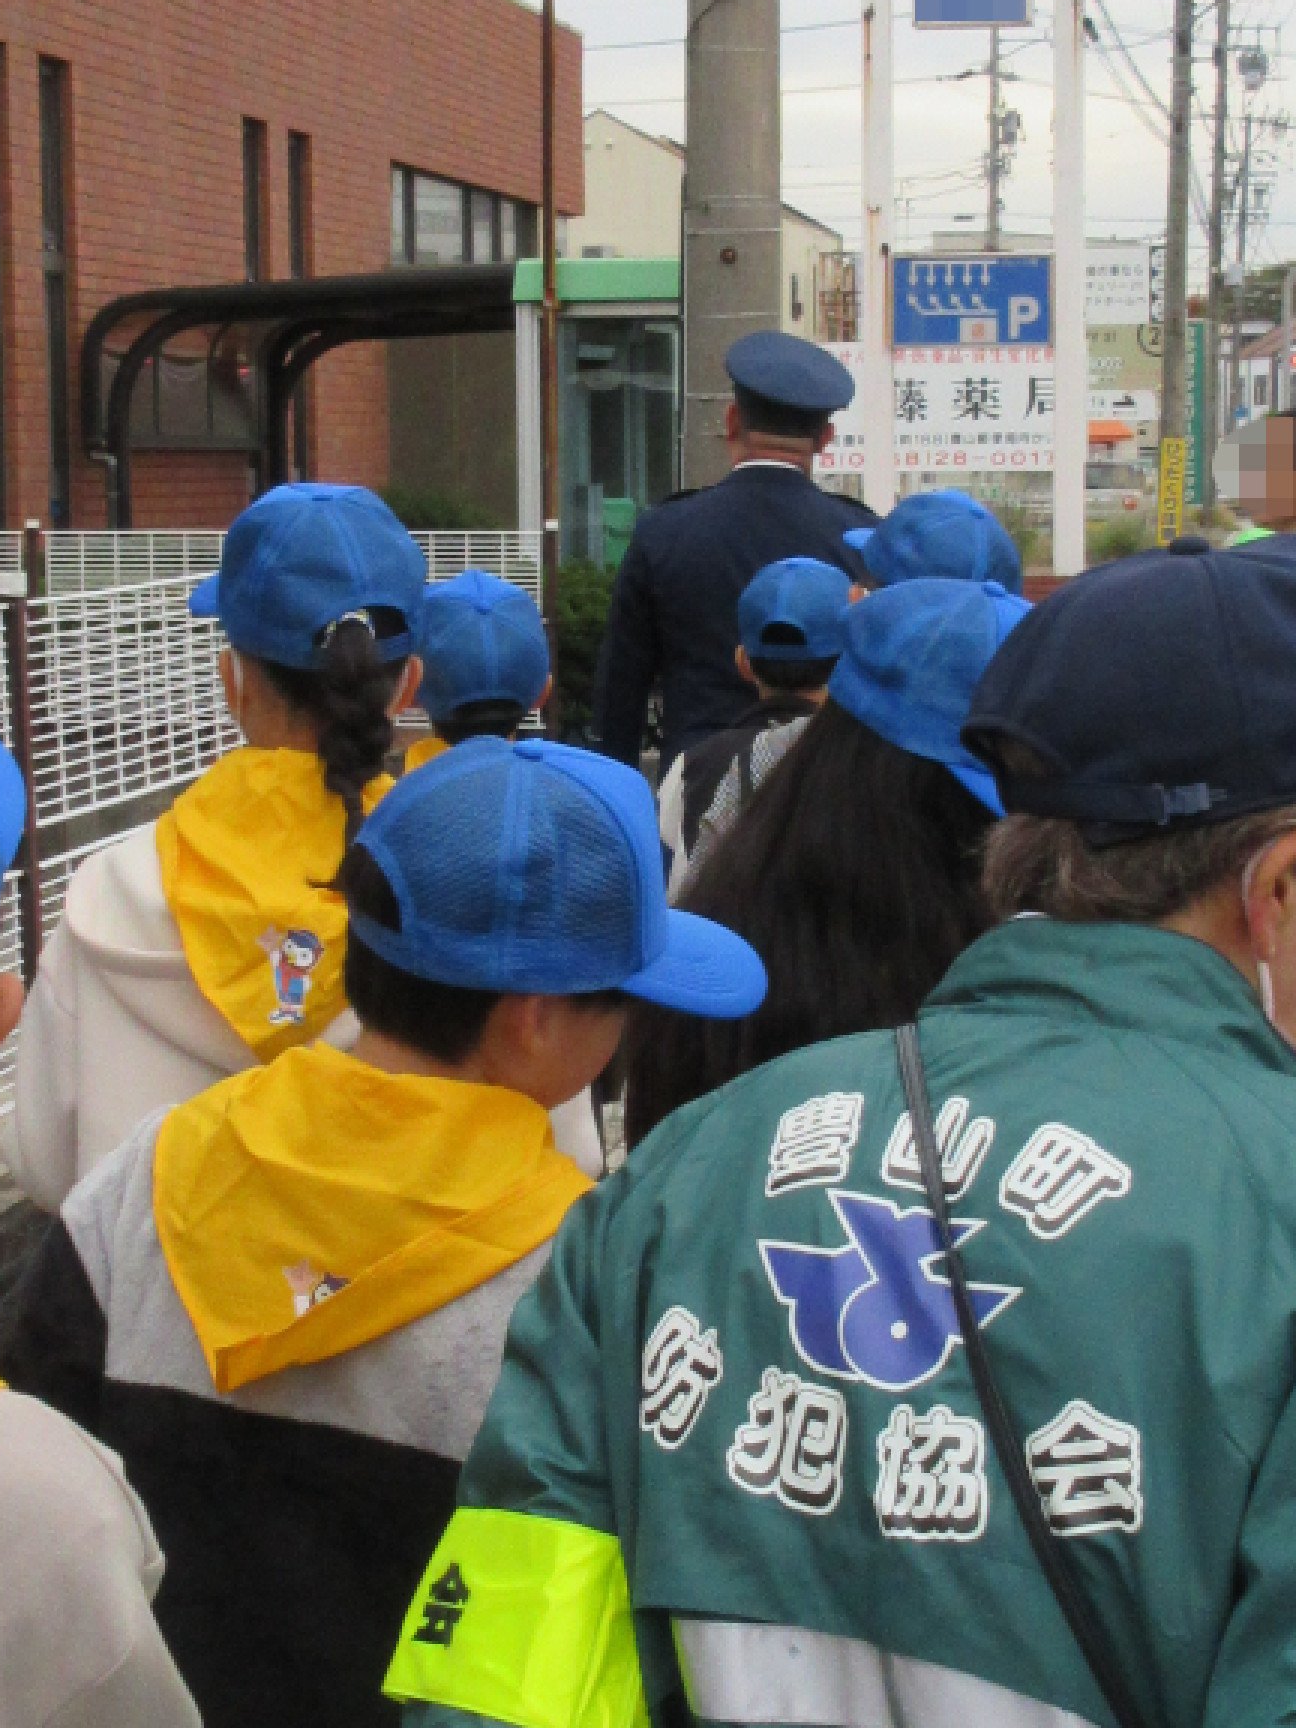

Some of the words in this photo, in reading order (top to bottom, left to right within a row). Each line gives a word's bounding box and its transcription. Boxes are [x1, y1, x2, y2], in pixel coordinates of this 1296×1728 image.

[1008, 297, 1040, 340] P
[765, 1092, 1132, 1239] 豊山町
[640, 1305, 1144, 1542] 防犯協会
